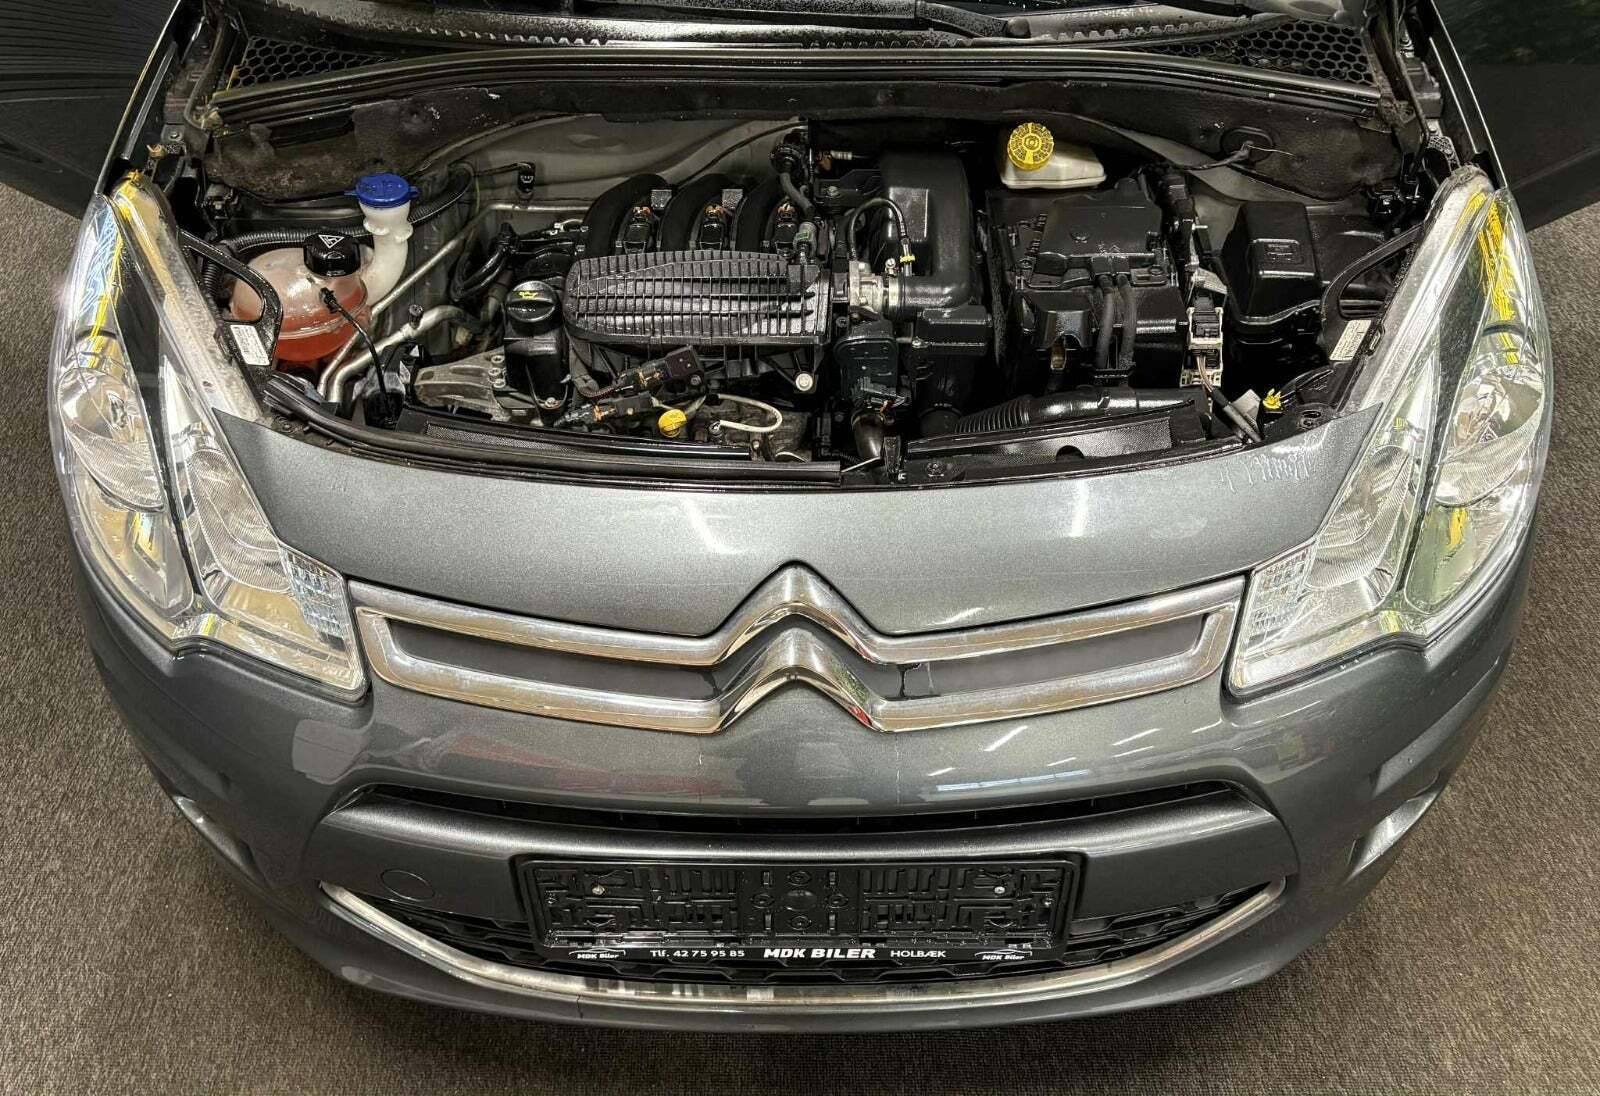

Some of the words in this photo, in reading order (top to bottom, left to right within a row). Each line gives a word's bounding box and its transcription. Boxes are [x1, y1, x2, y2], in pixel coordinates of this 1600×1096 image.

[763, 948, 806, 959] MDK
[810, 948, 876, 959] BILER
[890, 950, 947, 958] HOLBÆK
